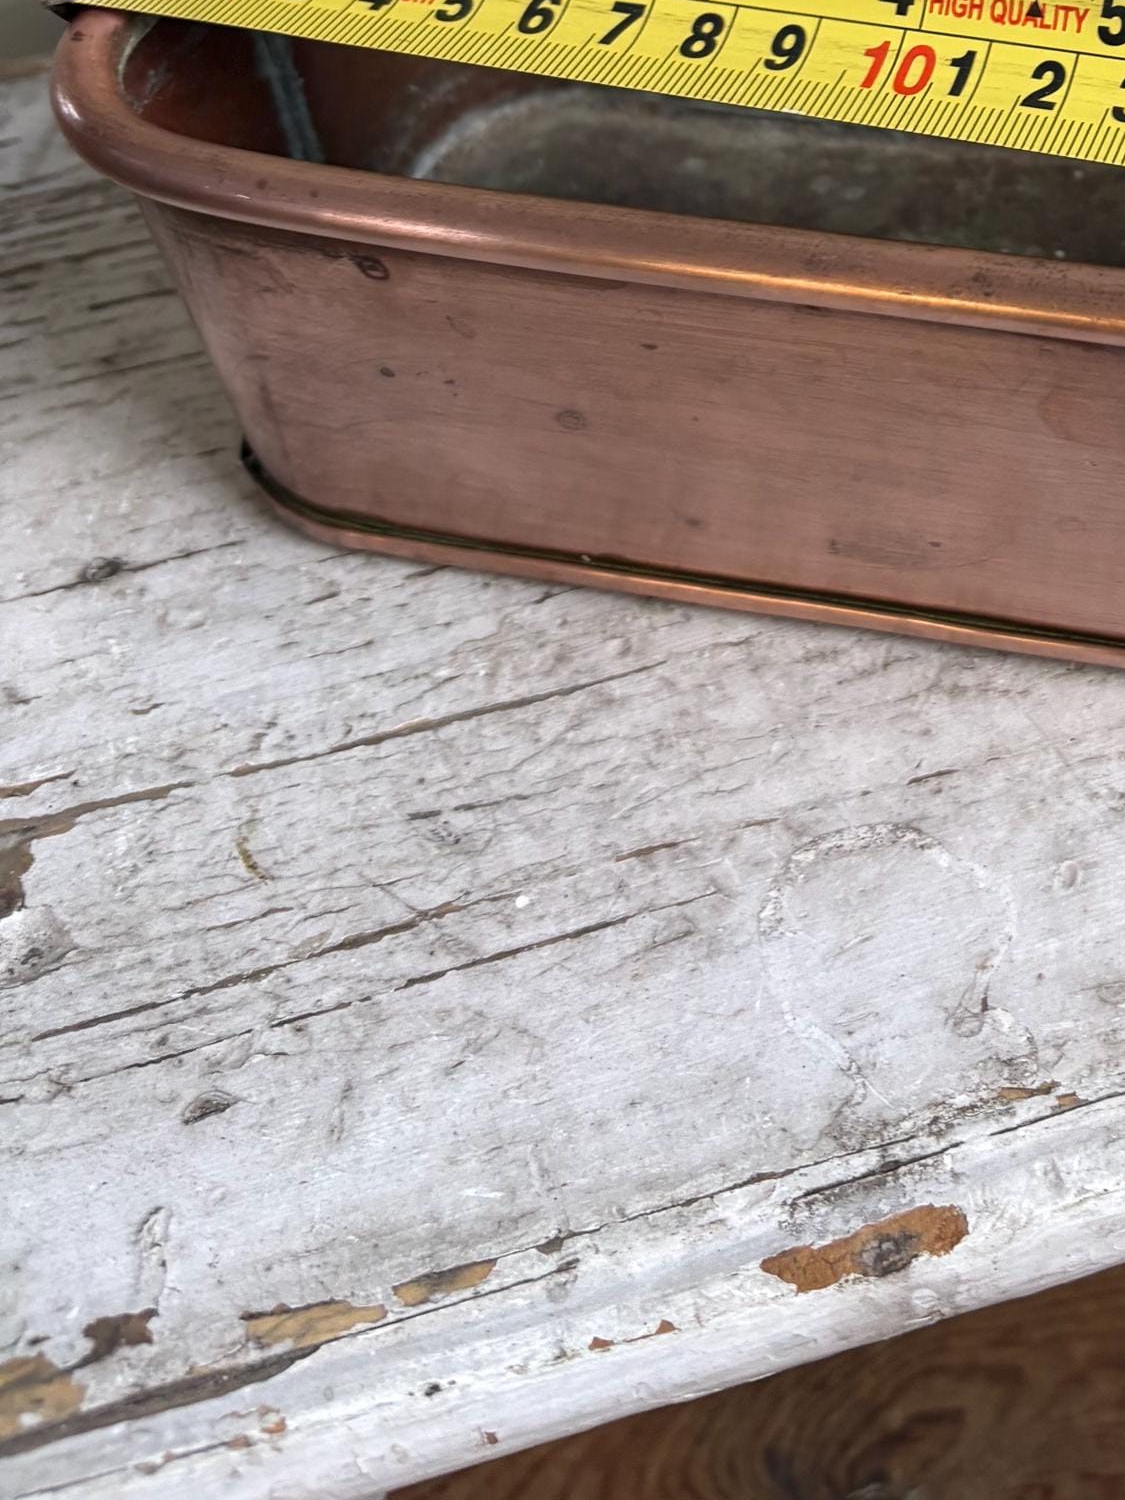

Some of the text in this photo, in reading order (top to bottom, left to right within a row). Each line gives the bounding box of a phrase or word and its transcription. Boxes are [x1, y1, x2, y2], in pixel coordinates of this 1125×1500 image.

[598, 1, 646, 46] 7
[680, 13, 724, 58] 8
[764, 24, 806, 71] 9
[859, 40, 936, 96] 10
[948, 50, 977, 96] 1
[1020, 60, 1066, 110] 2
